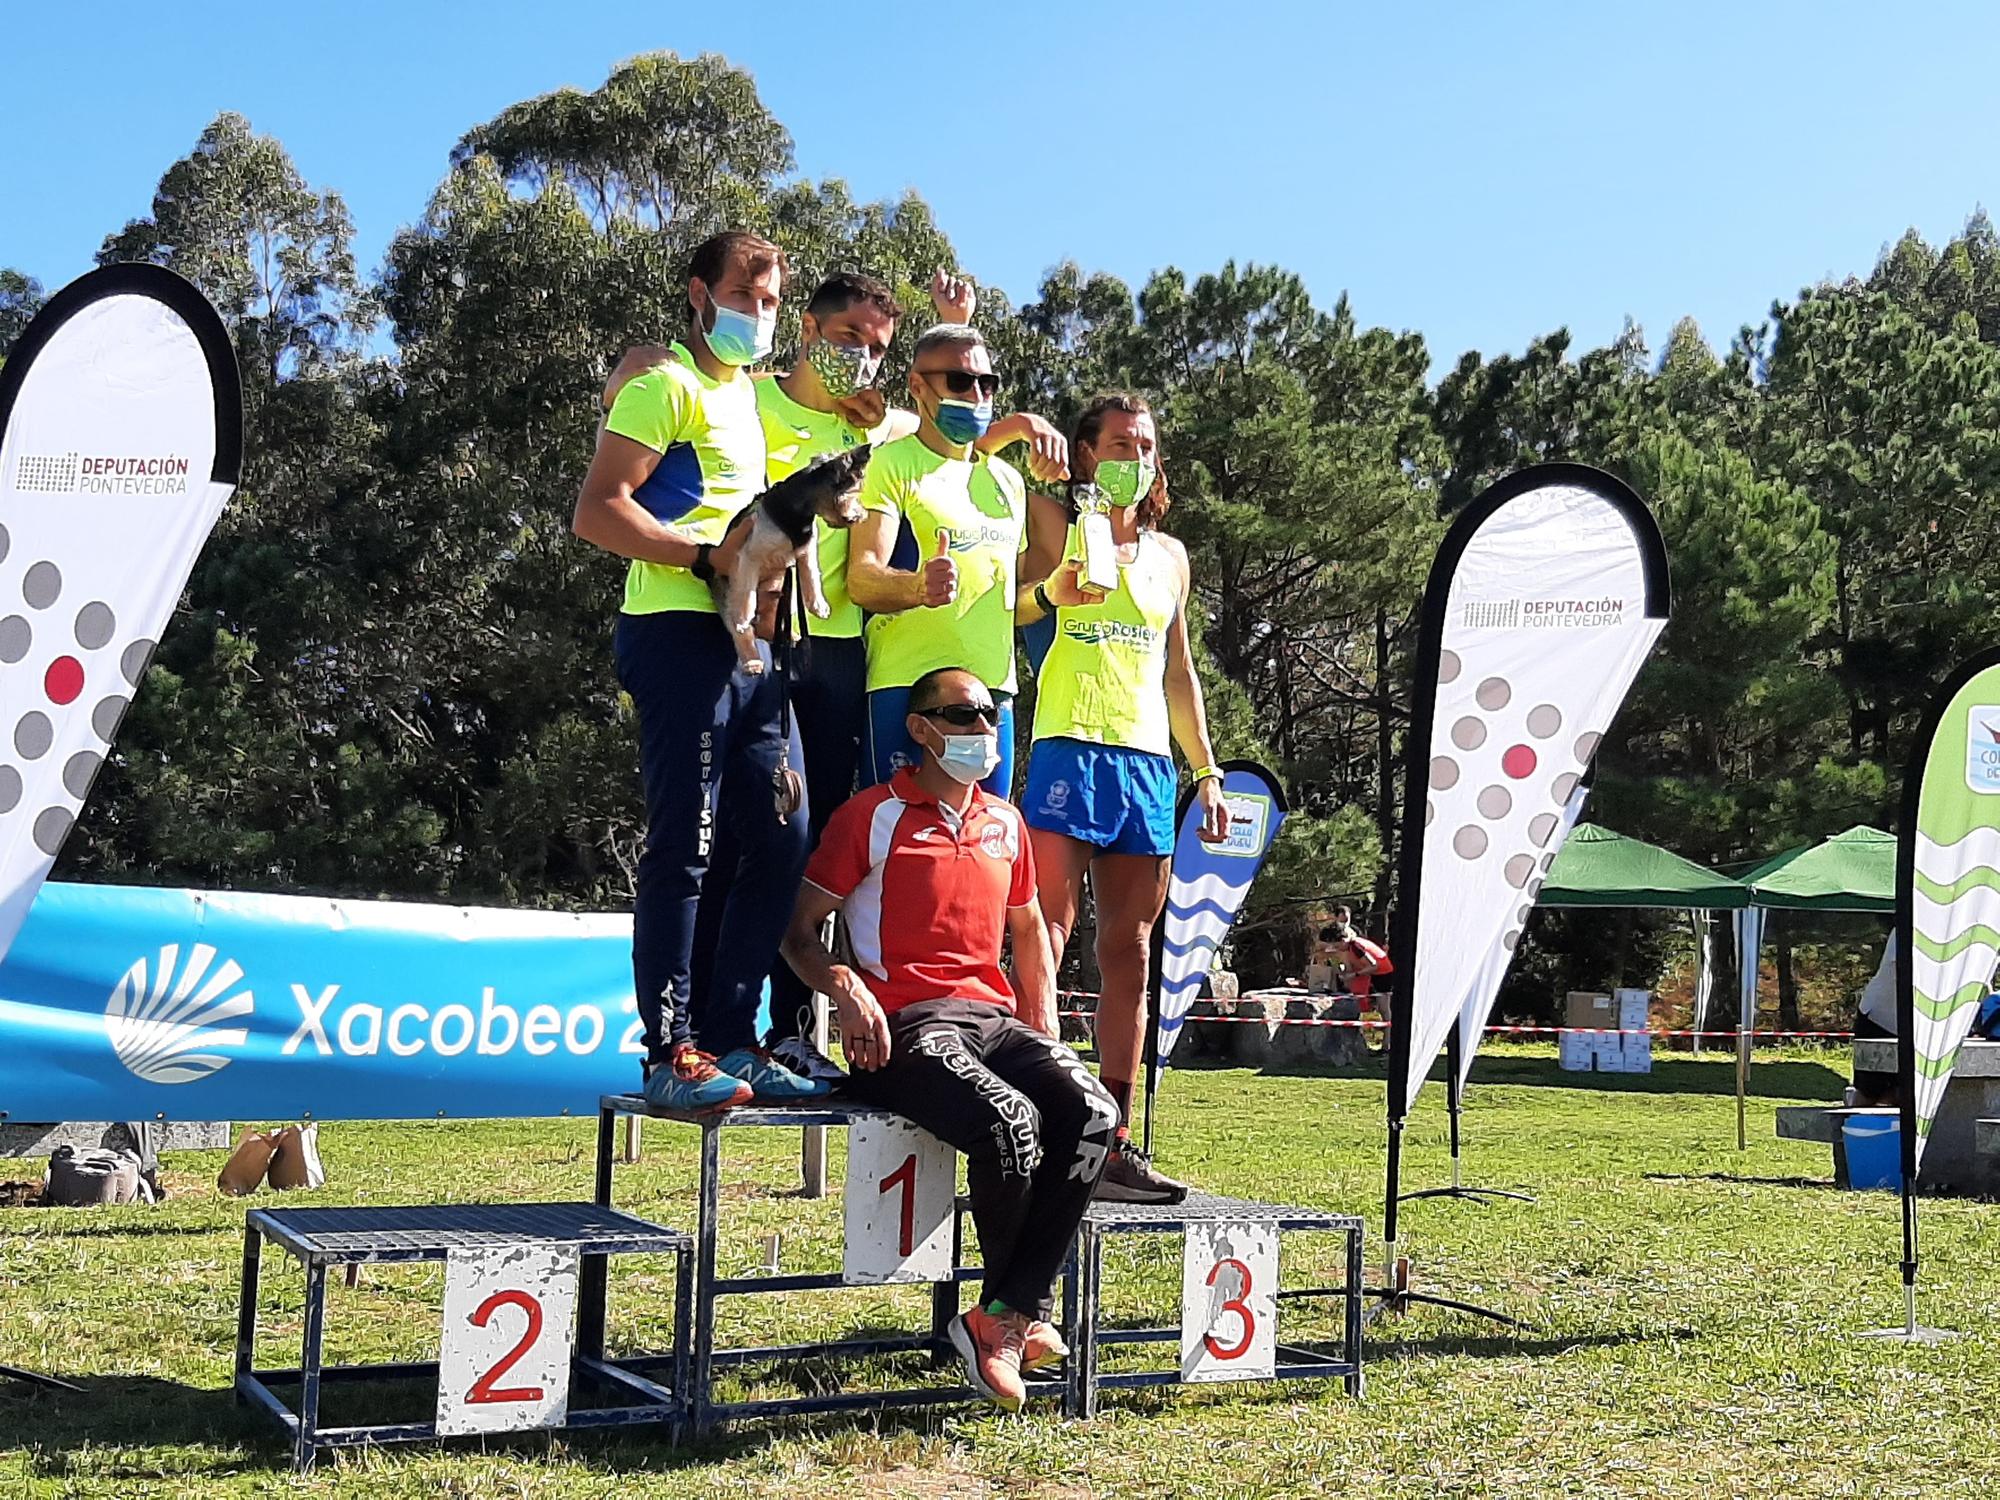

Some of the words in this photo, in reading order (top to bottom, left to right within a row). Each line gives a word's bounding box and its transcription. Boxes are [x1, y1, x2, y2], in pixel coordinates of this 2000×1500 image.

[79, 476, 188, 495] PONTEVEDRA
[82, 453, 189, 476] DEPUTACIÓN
[1522, 613, 1623, 628] PONTEVEDRA
[1523, 597, 1623, 614] DEPUTACIÓN
[281, 982, 604, 1058] Xacobeo
[878, 1152, 918, 1258] 1
[1202, 1257, 1254, 1361] 3
[464, 1288, 545, 1403] 2
